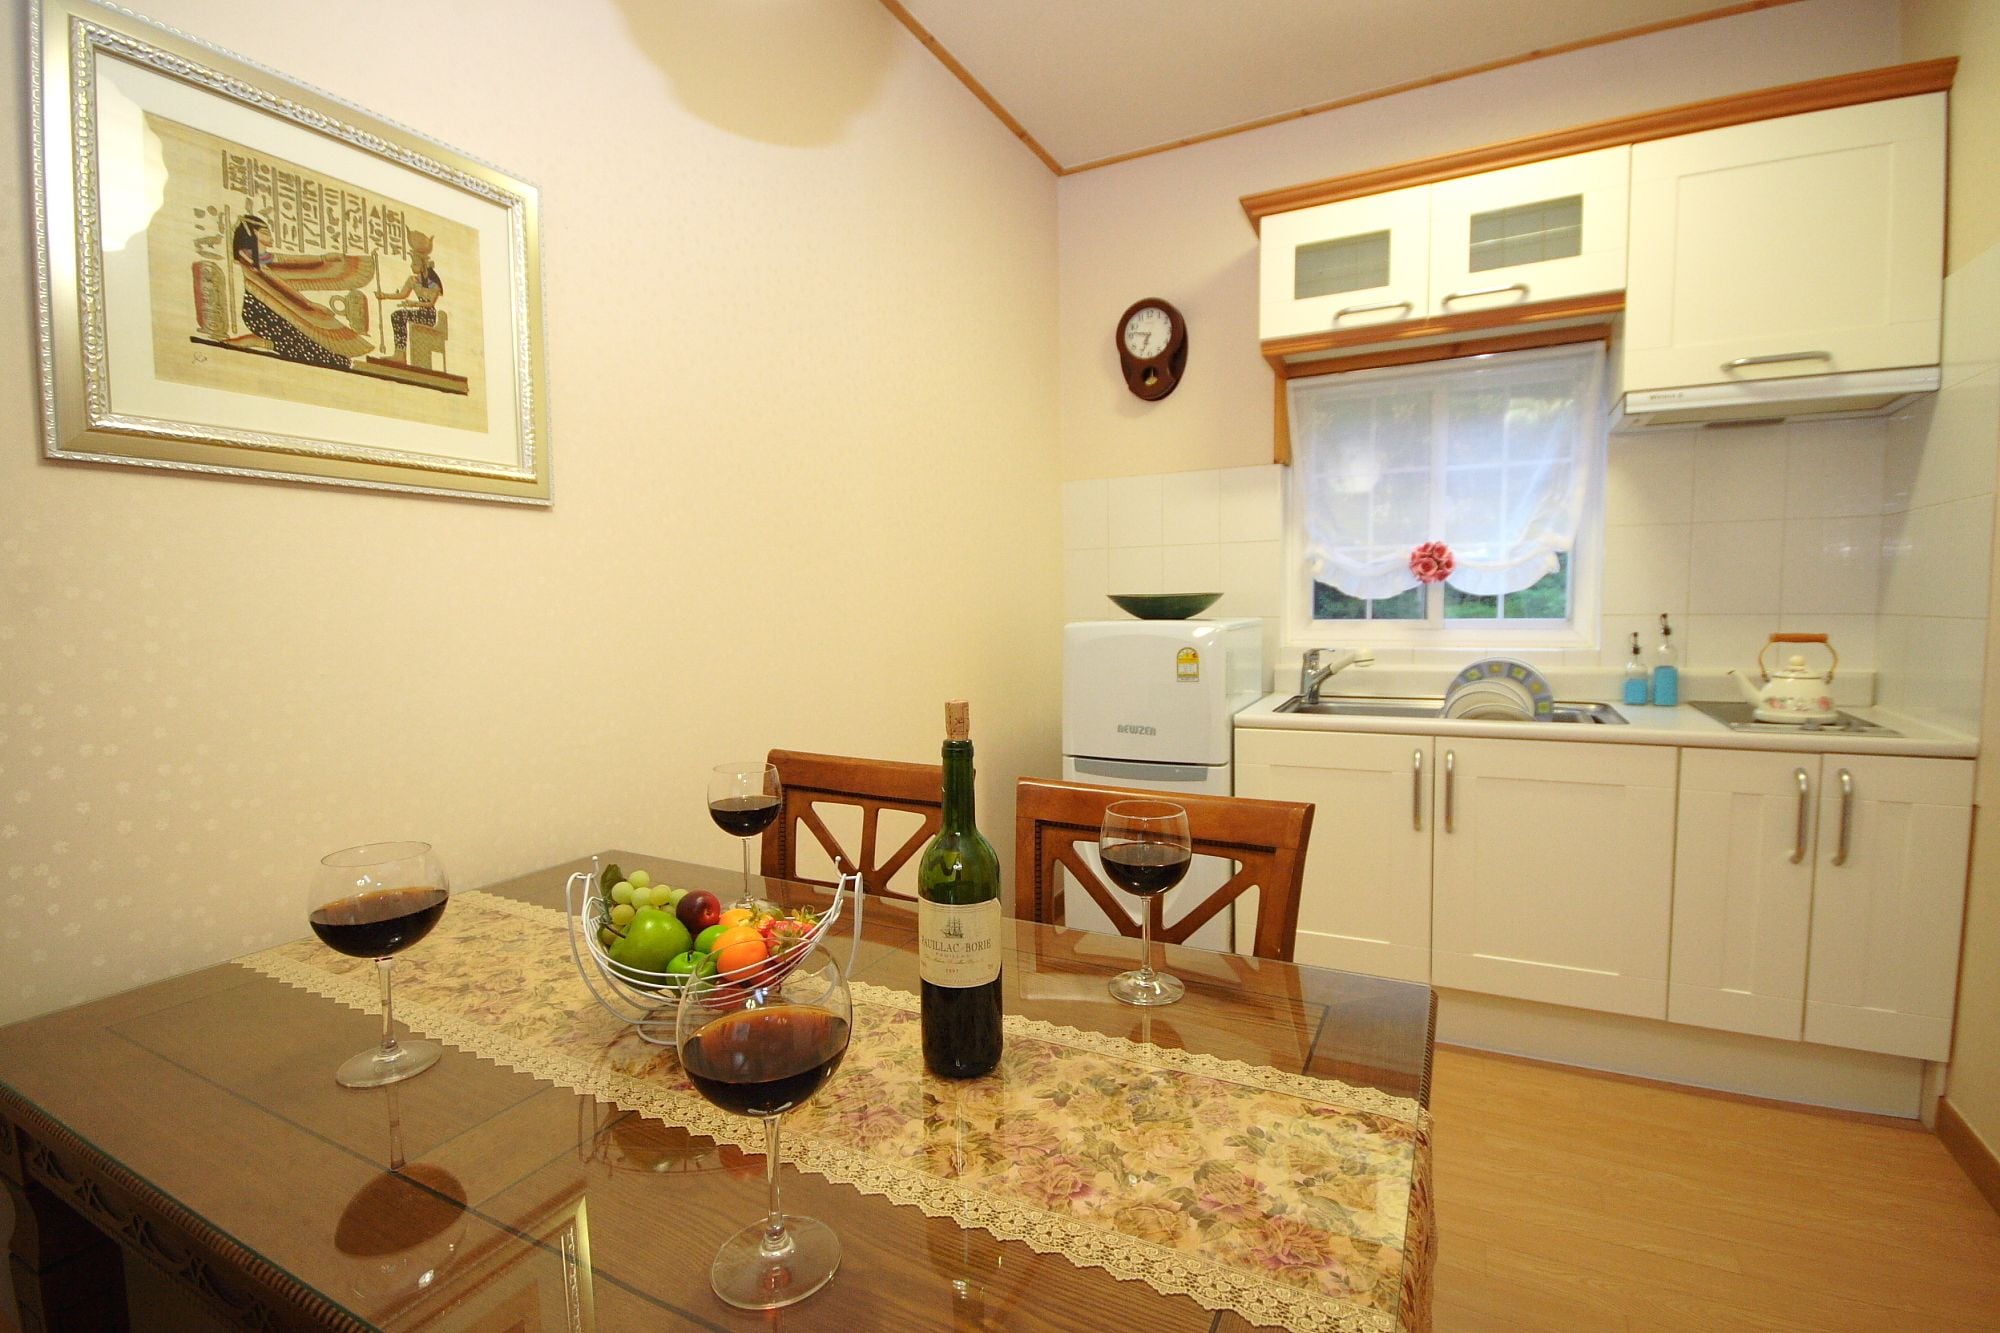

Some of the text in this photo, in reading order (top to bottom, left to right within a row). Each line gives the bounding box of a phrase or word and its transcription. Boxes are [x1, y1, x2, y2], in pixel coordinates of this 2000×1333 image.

[1138, 313, 1144, 321] 11
[1146, 309, 1154, 318] 12
[965, 938, 991, 953] BORIE
